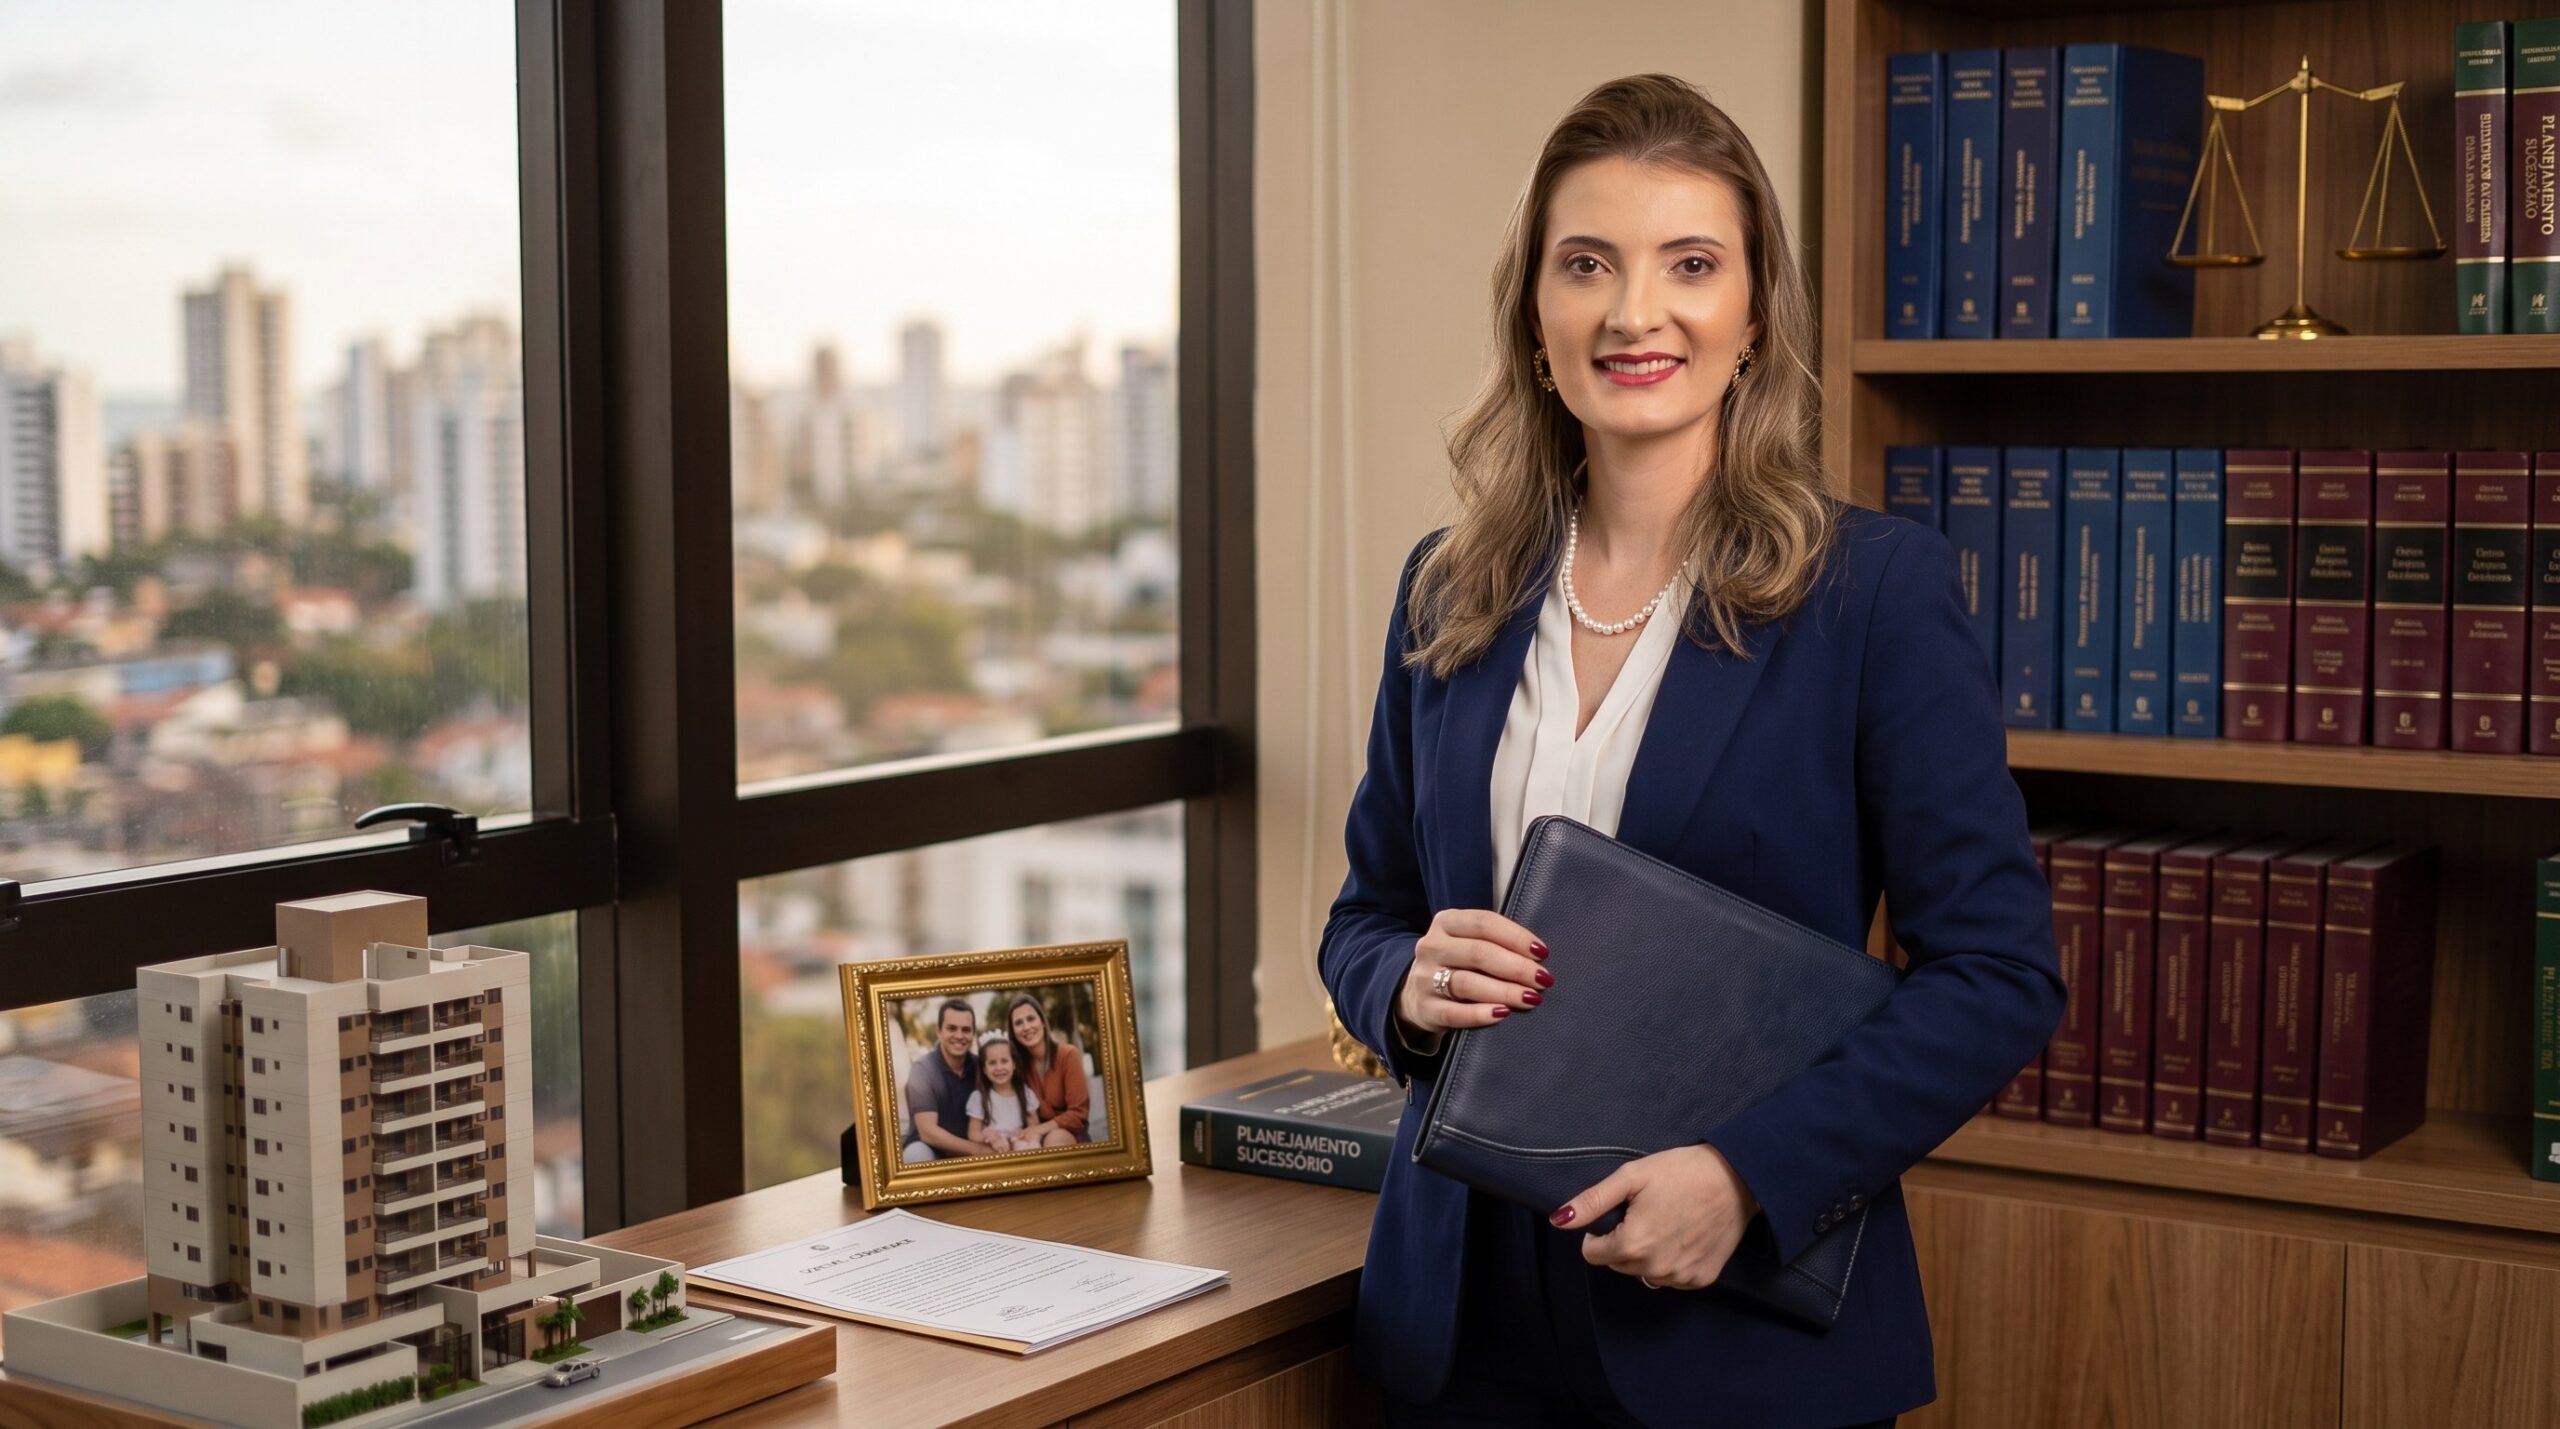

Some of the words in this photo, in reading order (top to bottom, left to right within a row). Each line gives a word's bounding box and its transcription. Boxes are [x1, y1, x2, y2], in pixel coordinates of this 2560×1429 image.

[2540, 115, 2555, 236] PLANEJAMENTO
[1237, 1126, 1361, 1158] PLANEJAMENTO
[1237, 1147, 1334, 1174] SUCESSÓRIO
